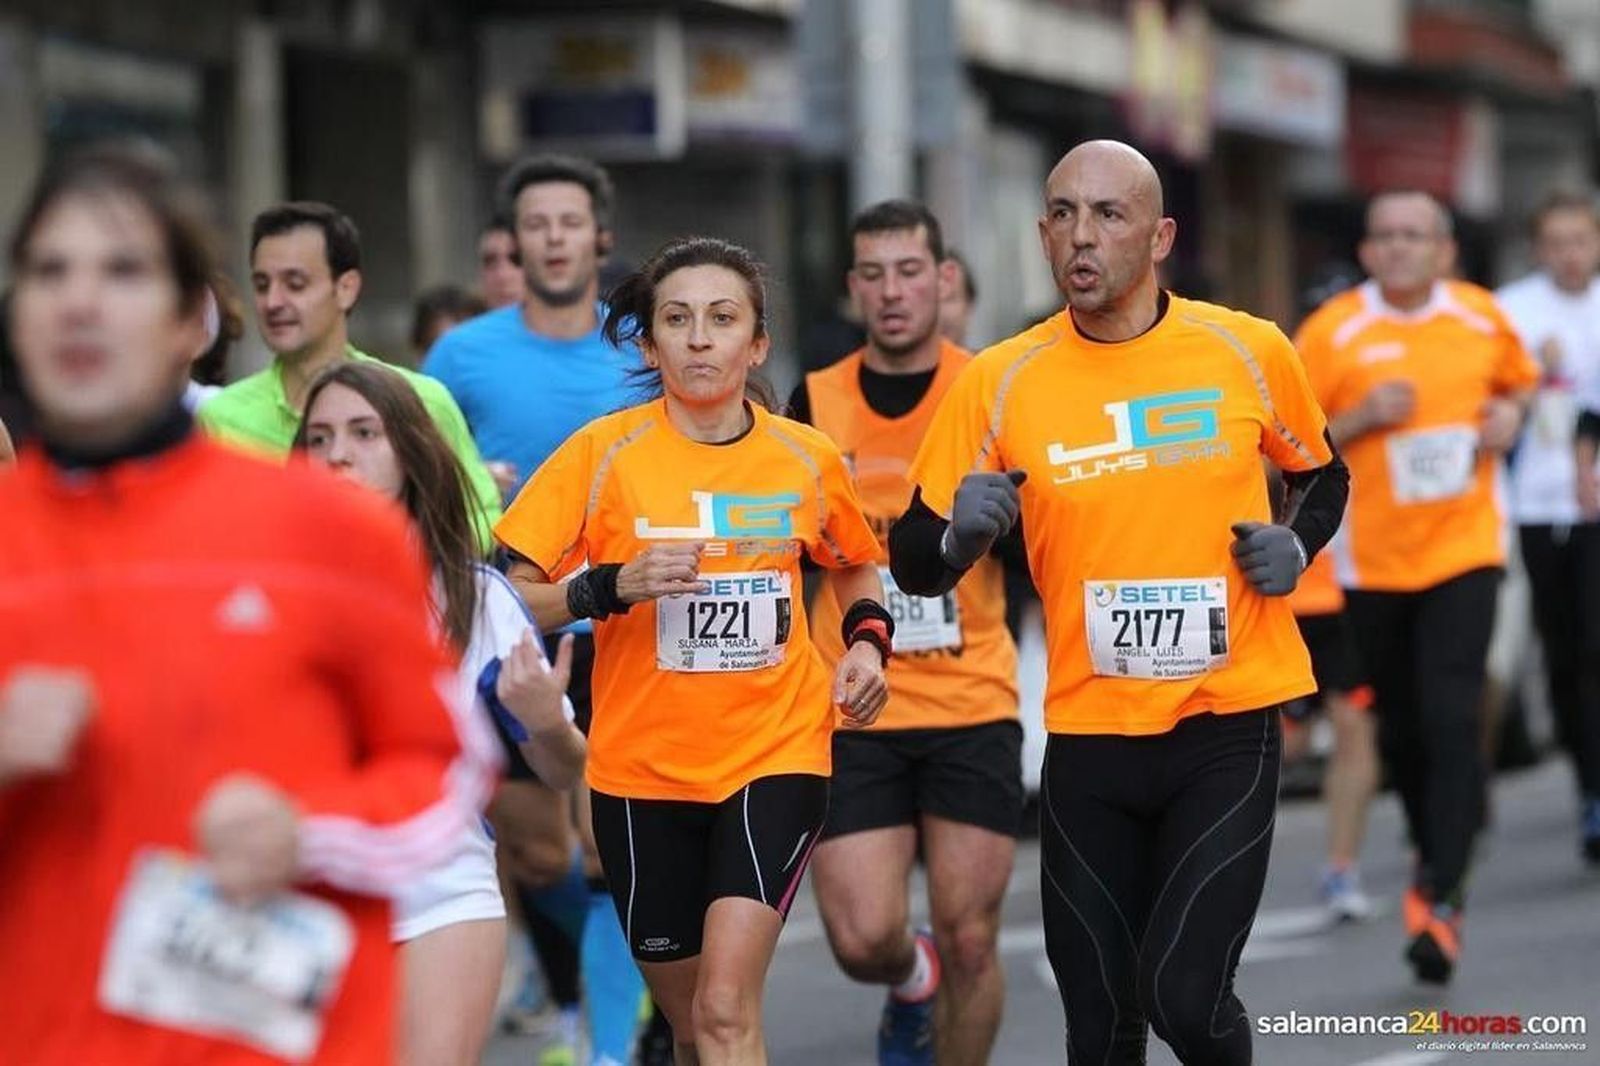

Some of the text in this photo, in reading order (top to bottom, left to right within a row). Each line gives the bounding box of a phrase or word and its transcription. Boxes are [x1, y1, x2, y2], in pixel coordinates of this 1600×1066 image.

[1048, 388, 1223, 465] JG
[1053, 453, 1149, 485] JUYS
[634, 490, 800, 538] JG
[1120, 584, 1216, 603] SETEL
[687, 601, 750, 639] 1221
[1111, 608, 1185, 647] 2177
[677, 638, 719, 649] SUSANA
[1117, 647, 1184, 657] ANGEL LUIS
